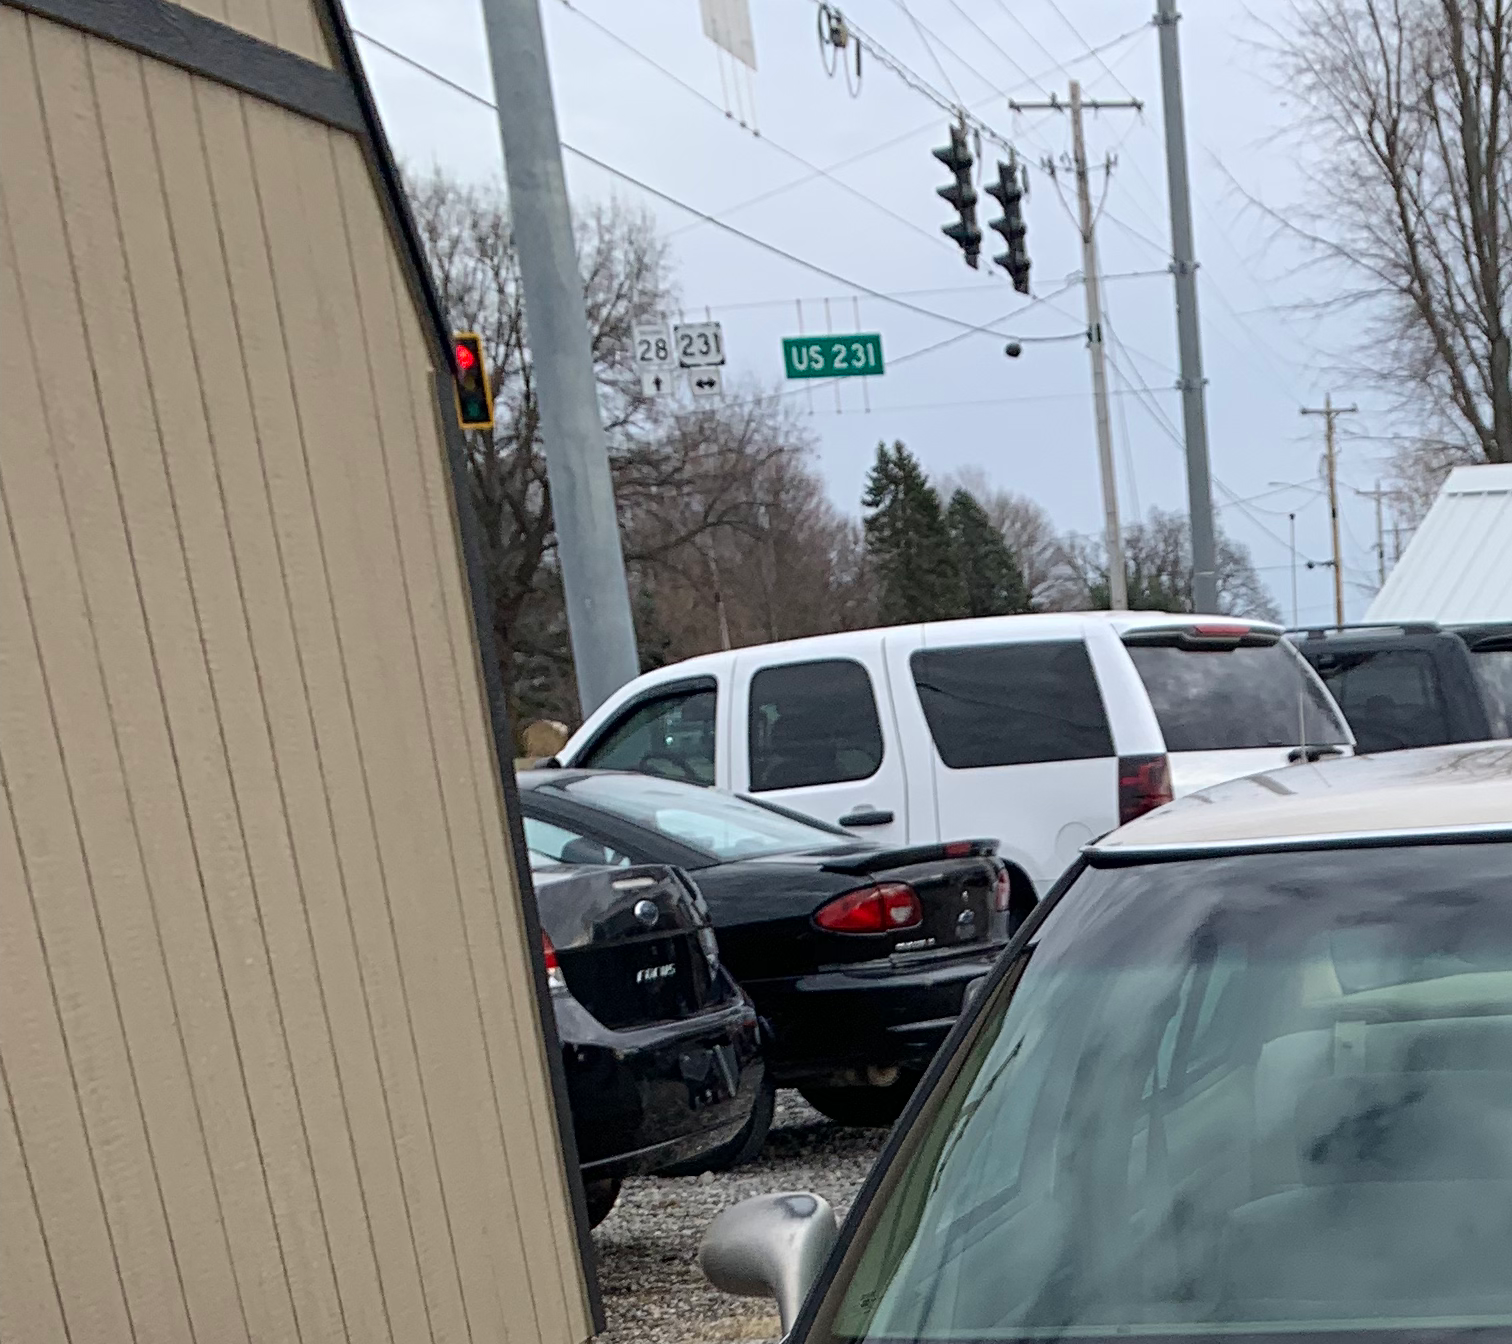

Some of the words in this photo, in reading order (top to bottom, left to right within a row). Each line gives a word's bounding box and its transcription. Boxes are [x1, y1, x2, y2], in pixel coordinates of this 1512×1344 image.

[639, 338, 668, 361] 28
[680, 332, 720, 357] 231
[791, 345, 825, 371] US
[831, 342, 876, 370] 231
